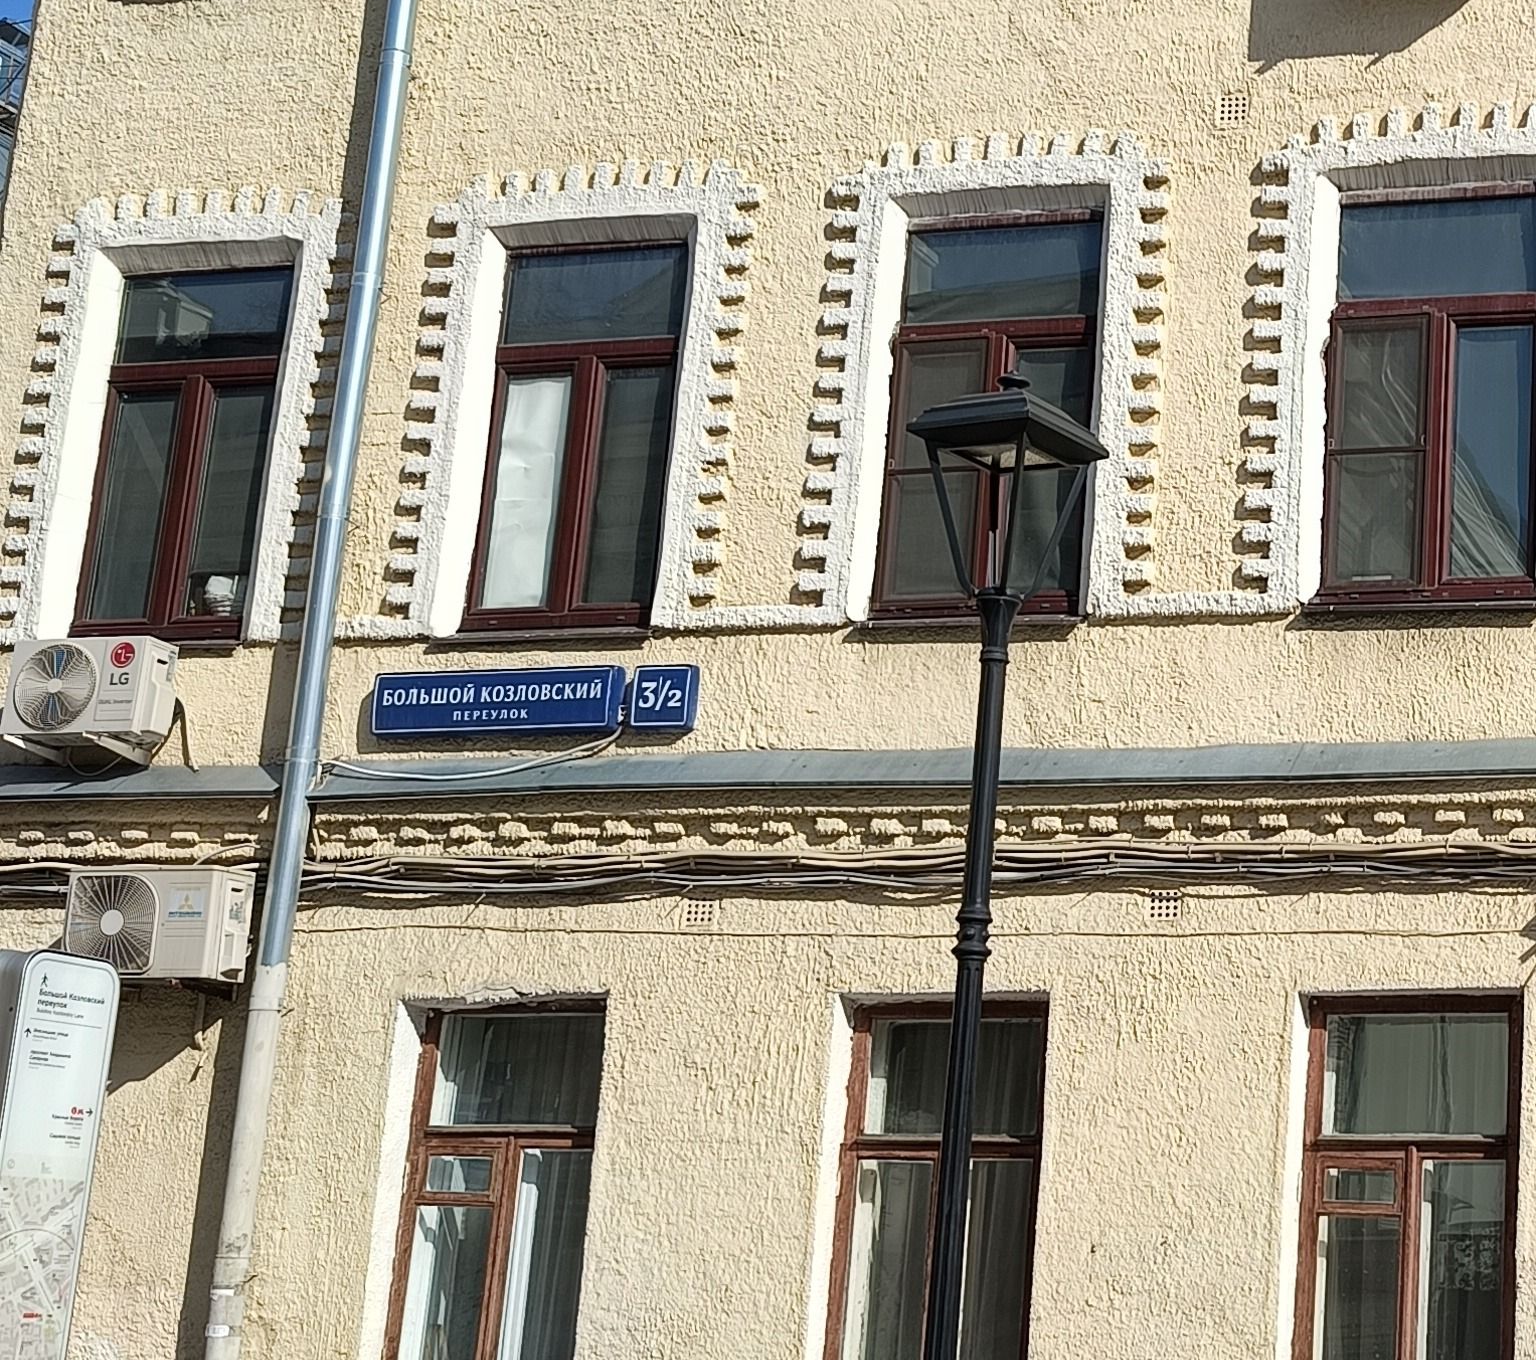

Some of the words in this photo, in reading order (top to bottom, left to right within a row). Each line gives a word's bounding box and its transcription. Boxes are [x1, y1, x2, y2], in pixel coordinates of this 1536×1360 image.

[109, 672, 130, 686] LG
[382, 683, 475, 706] БОЛЬШОЙ
[480, 678, 603, 703] КОЗЛОВСКИЙ
[638, 675, 682, 711] 3/2
[452, 708, 529, 721] ПЕРЕУЛОК
